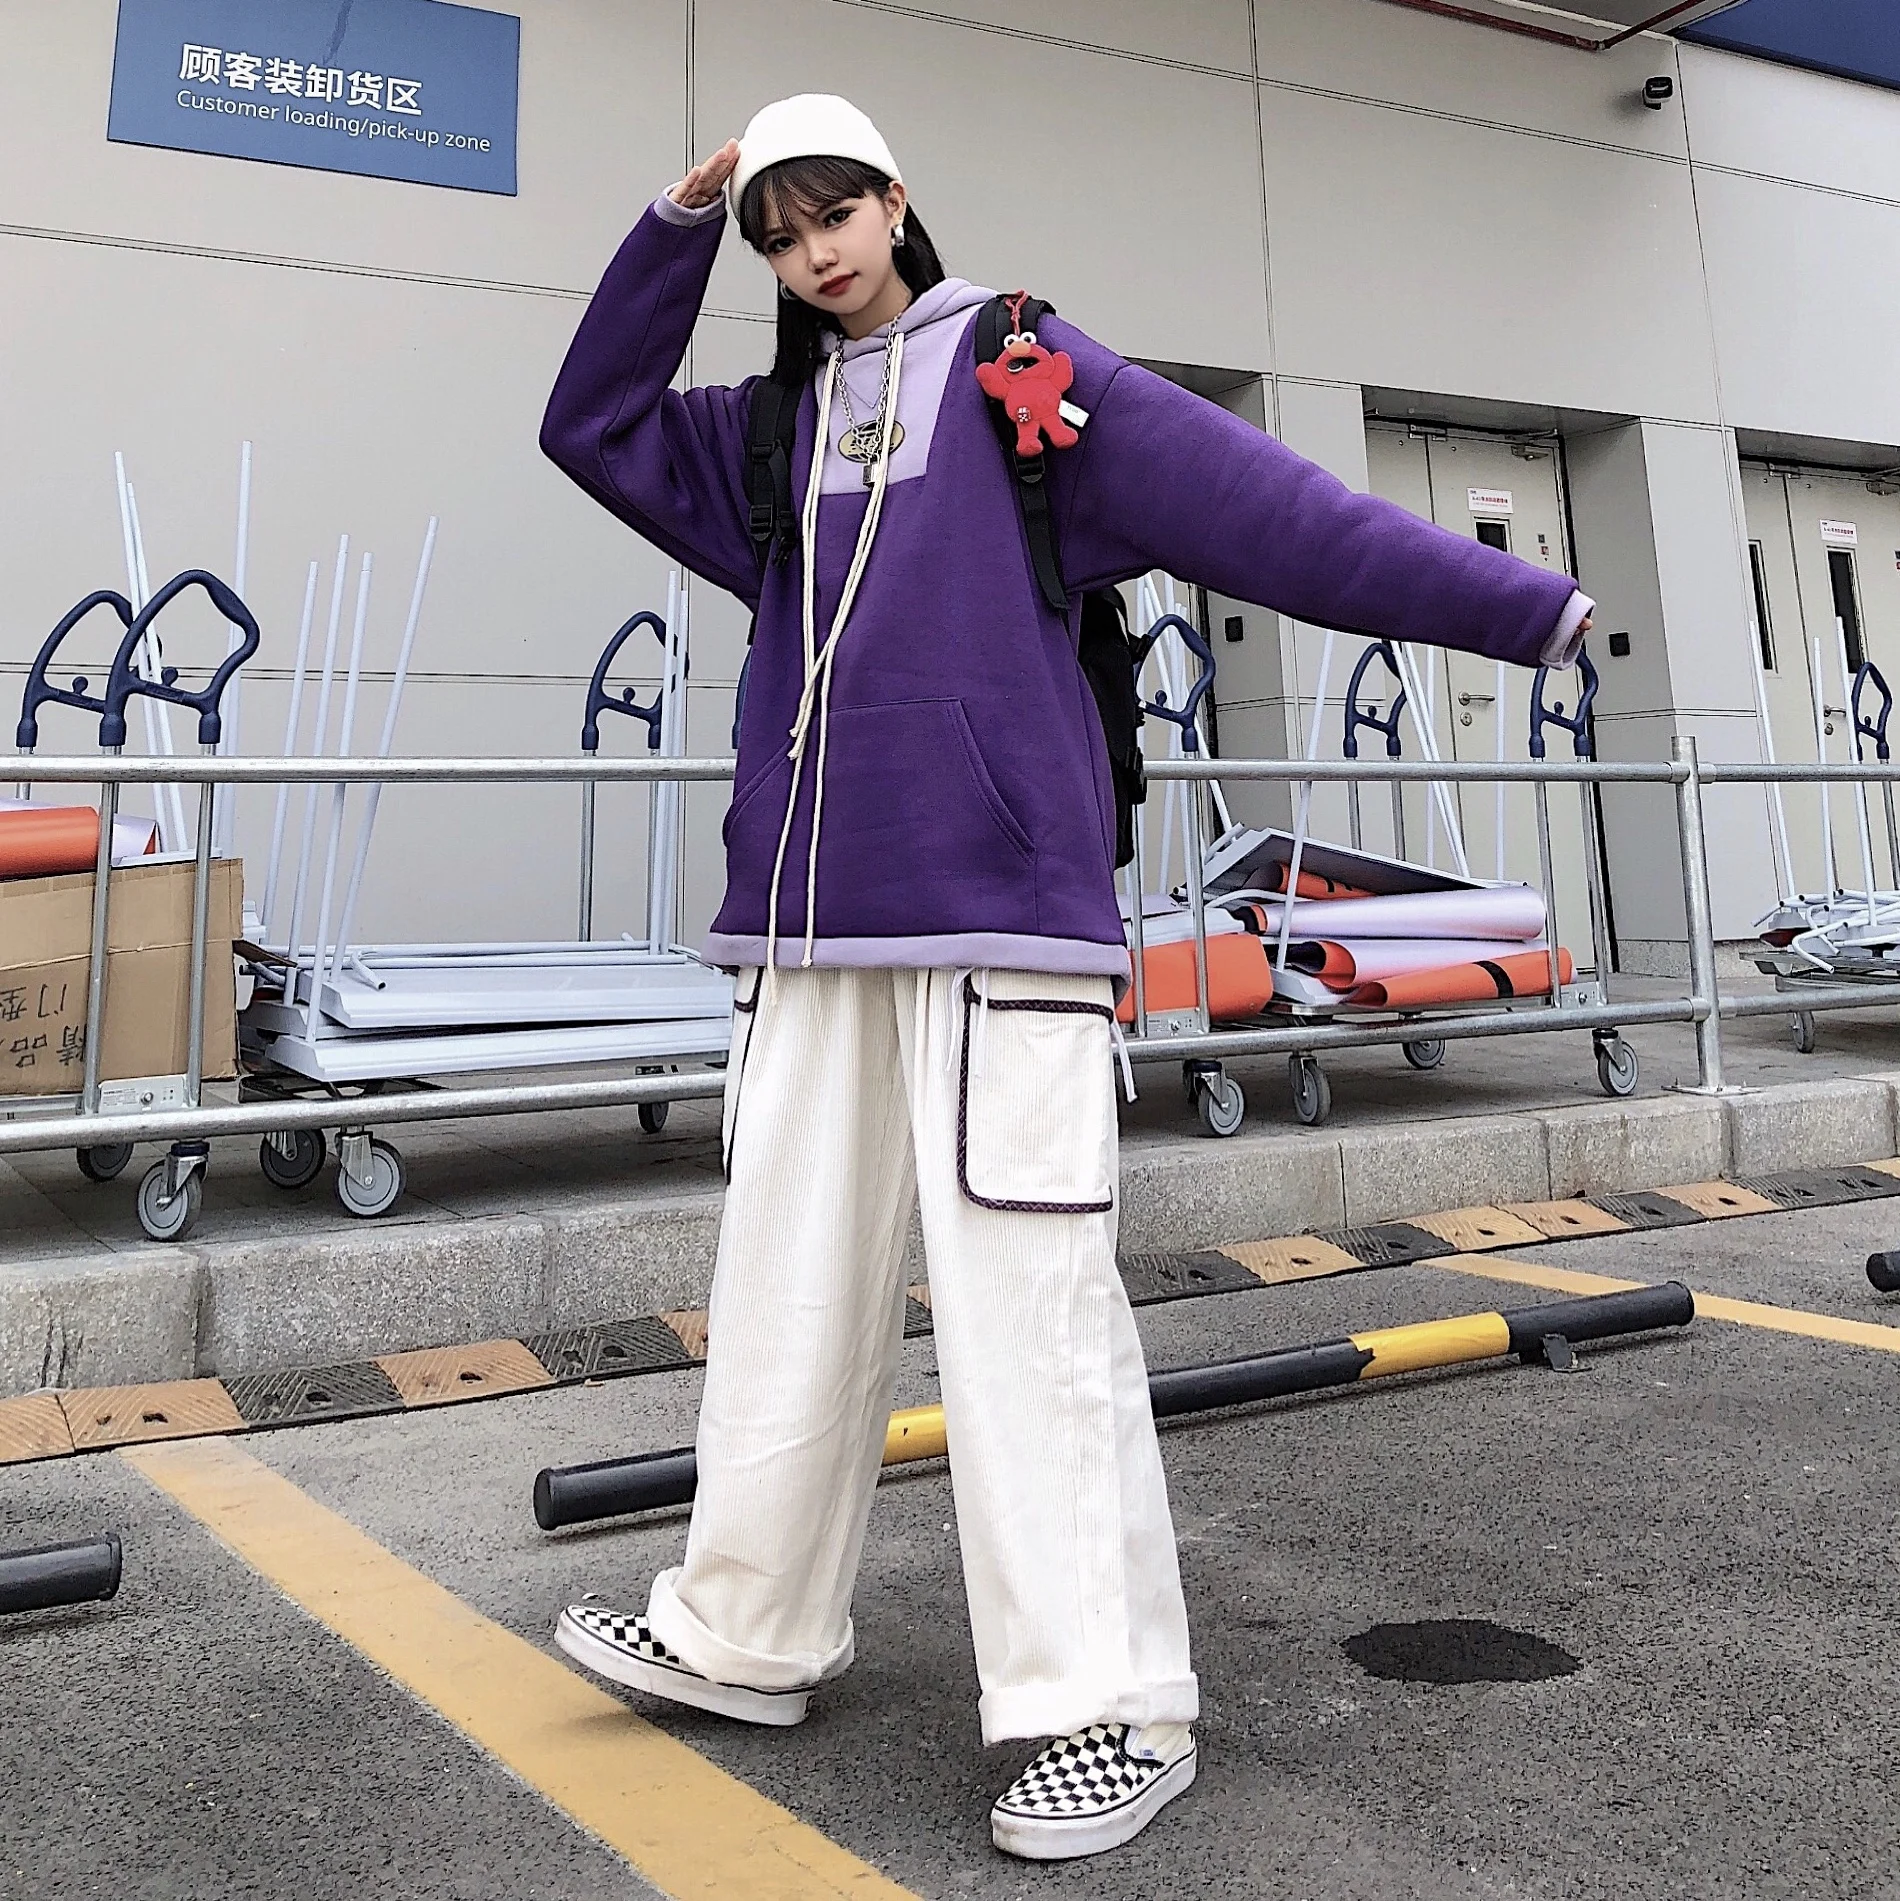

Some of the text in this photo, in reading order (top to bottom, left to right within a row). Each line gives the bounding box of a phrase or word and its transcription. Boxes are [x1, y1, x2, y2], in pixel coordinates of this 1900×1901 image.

[178, 43, 423, 116] 顾客装卸货区
[176, 89, 492, 152] Customer loading/pick-up zone
[0, 1023, 87, 1069] 精品
